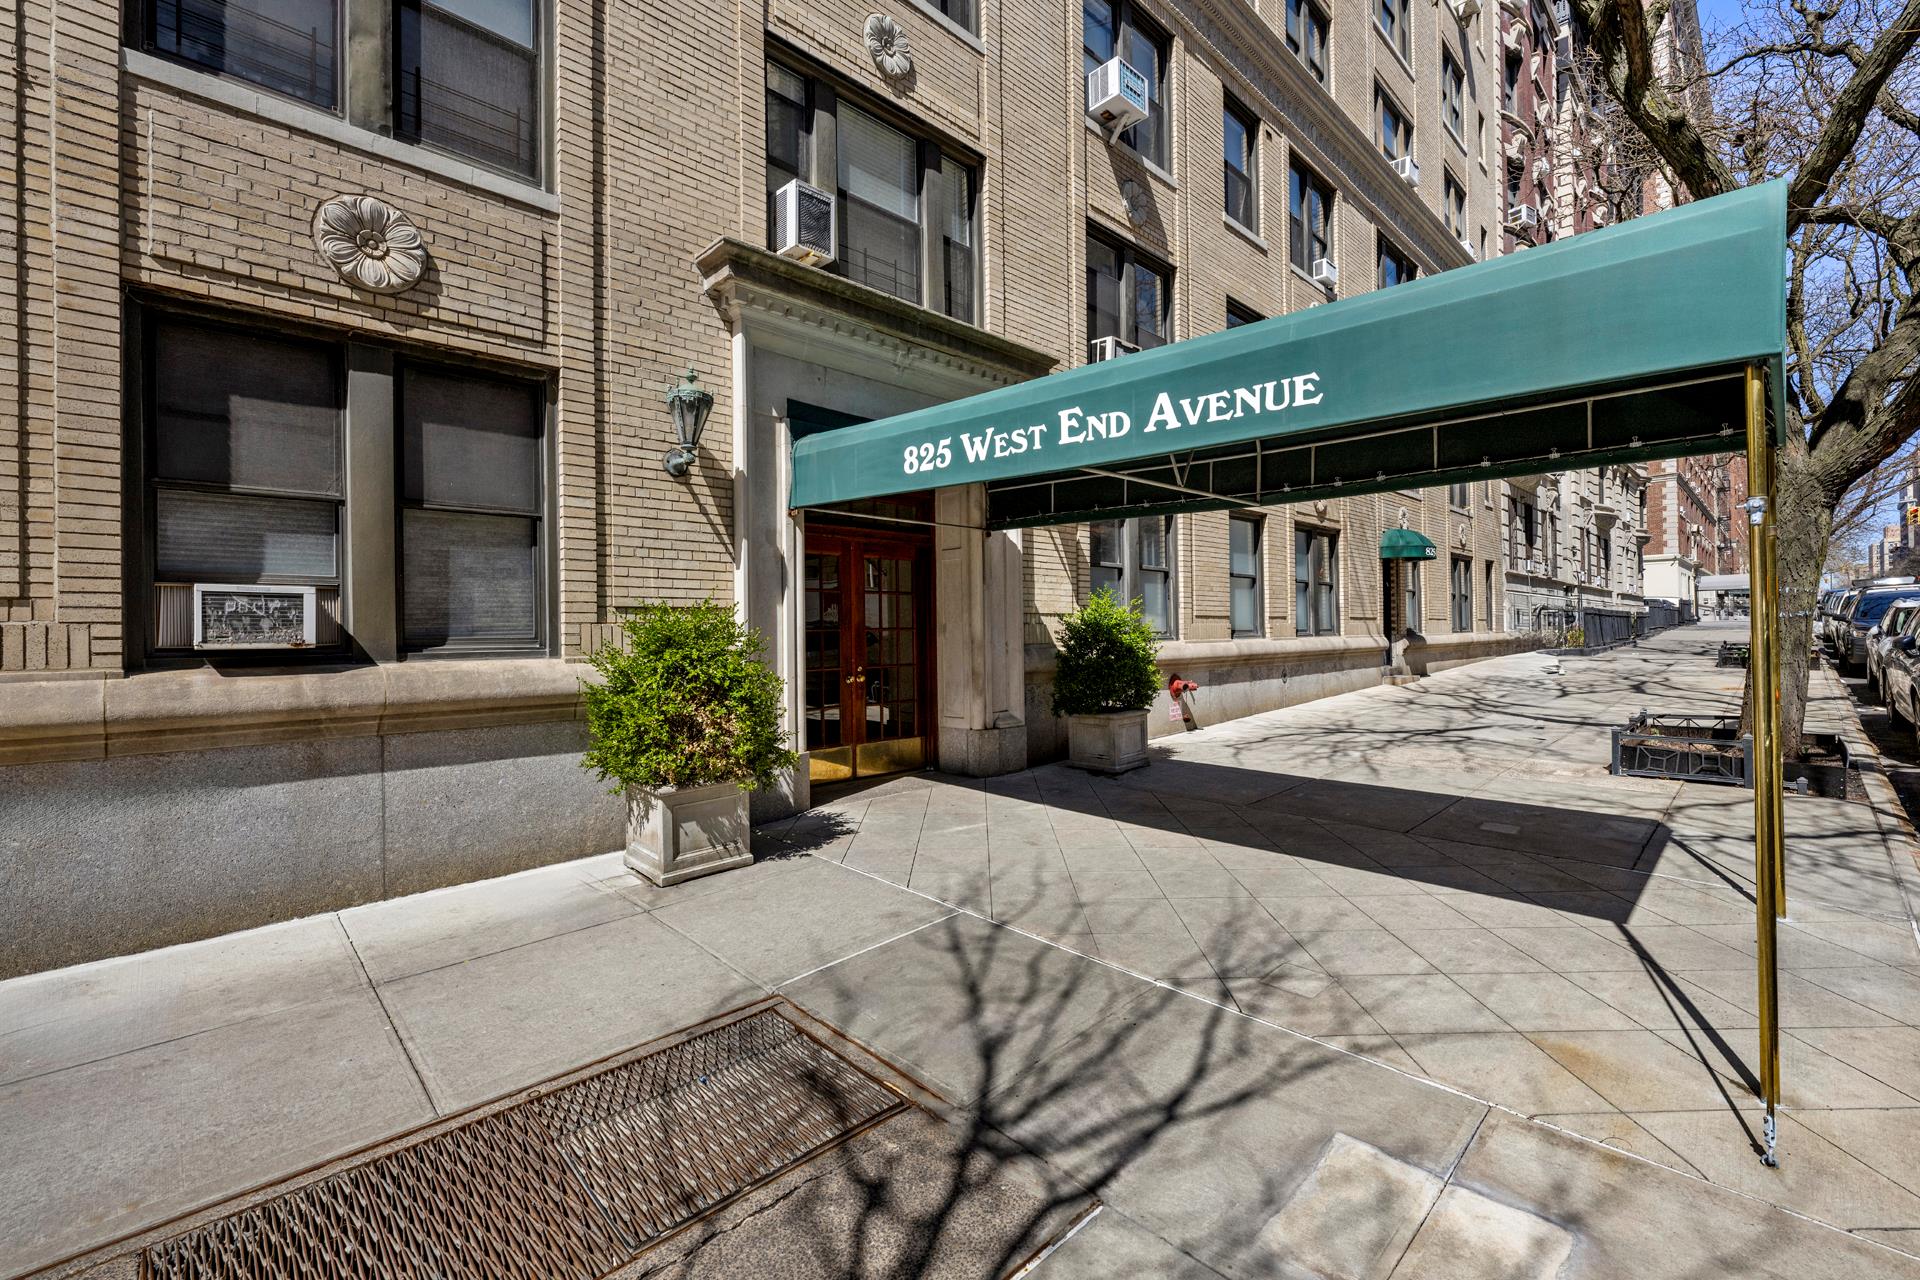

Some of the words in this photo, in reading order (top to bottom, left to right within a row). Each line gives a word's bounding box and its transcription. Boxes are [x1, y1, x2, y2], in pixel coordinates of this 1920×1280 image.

[903, 437, 952, 475] 825
[960, 424, 1048, 464] WEST
[1058, 406, 1131, 446] END
[1144, 371, 1324, 432] AVENUE
